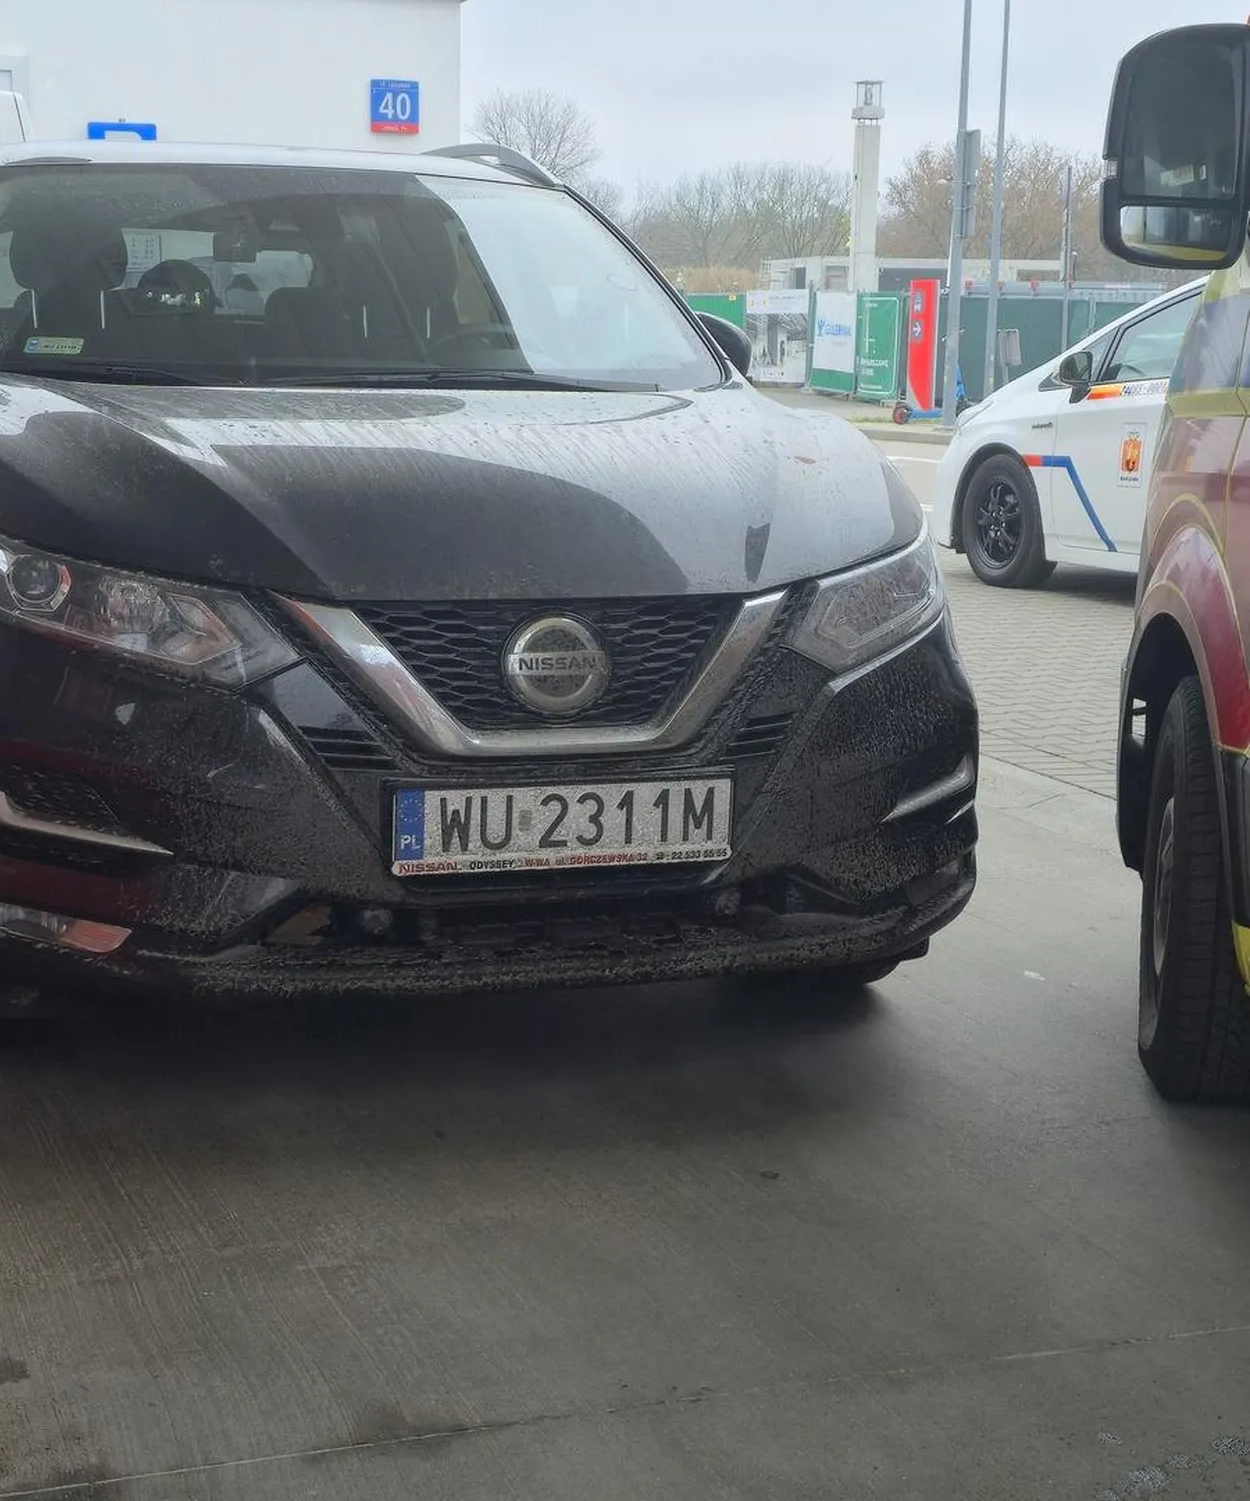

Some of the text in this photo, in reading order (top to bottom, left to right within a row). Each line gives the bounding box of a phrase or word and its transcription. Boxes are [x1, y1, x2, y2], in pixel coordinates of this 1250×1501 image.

[379, 91, 412, 120] 40
[518, 656, 597, 672] NISSAN
[439, 786, 715, 852] WU 2311M
[400, 834, 421, 850] PL
[399, 862, 458, 874] NISSAN
[469, 858, 515, 871] ODYSSEY
